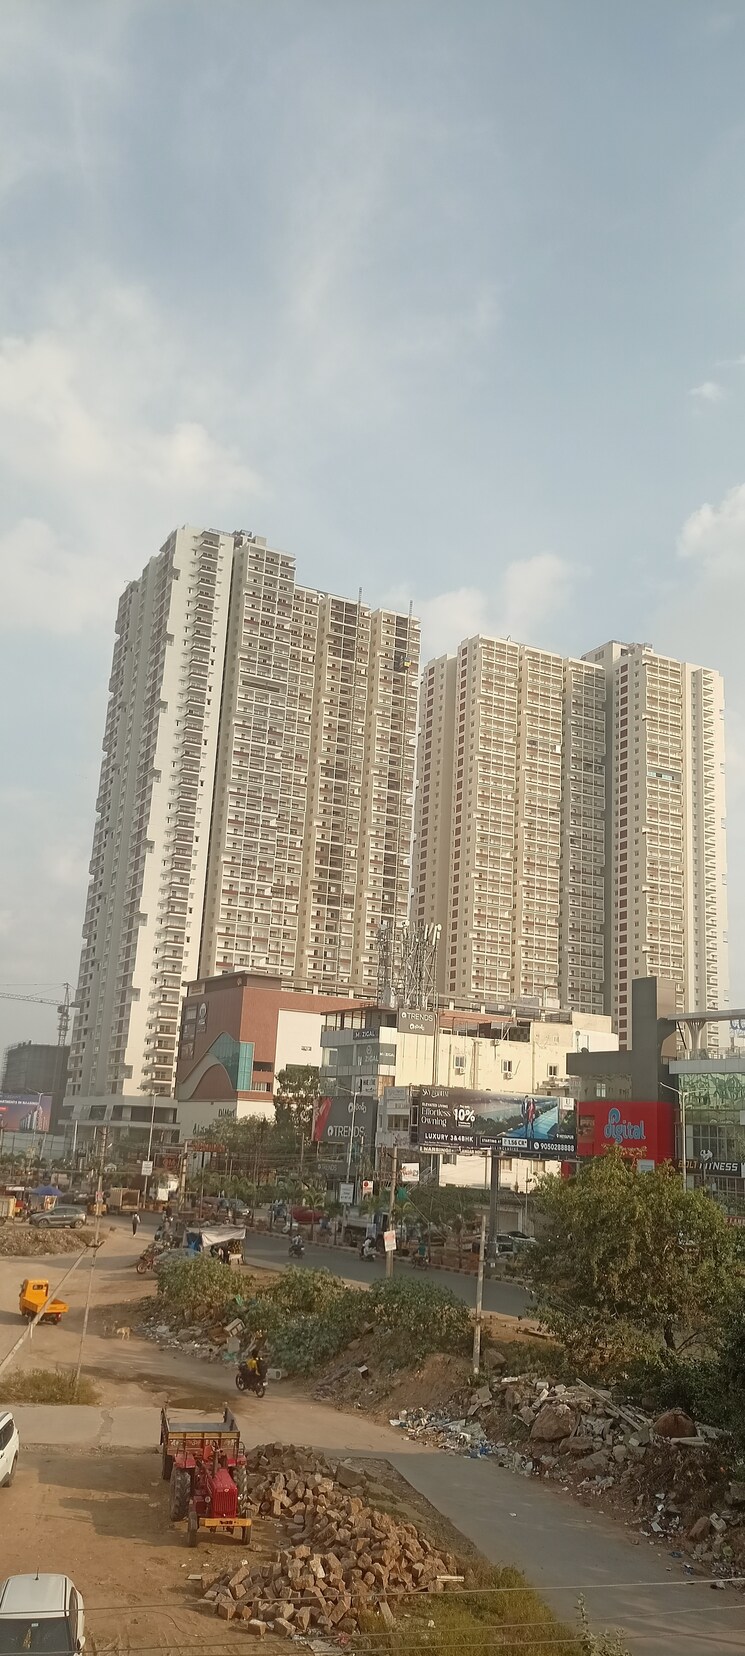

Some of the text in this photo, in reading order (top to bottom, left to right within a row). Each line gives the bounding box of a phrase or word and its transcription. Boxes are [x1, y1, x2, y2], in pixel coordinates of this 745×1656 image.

[407, 1012, 433, 1021] TRENDS
[421, 1106, 451, 1117] Effortless
[453, 1108, 476, 1122] 10%
[420, 1116, 447, 1127] Owning
[604, 1108, 646, 1144] digital
[333, 1125, 365, 1138] TRENDS
[425, 1132, 448, 1141] LUXURY
[540, 1142, 575, 1152] 9050288888
